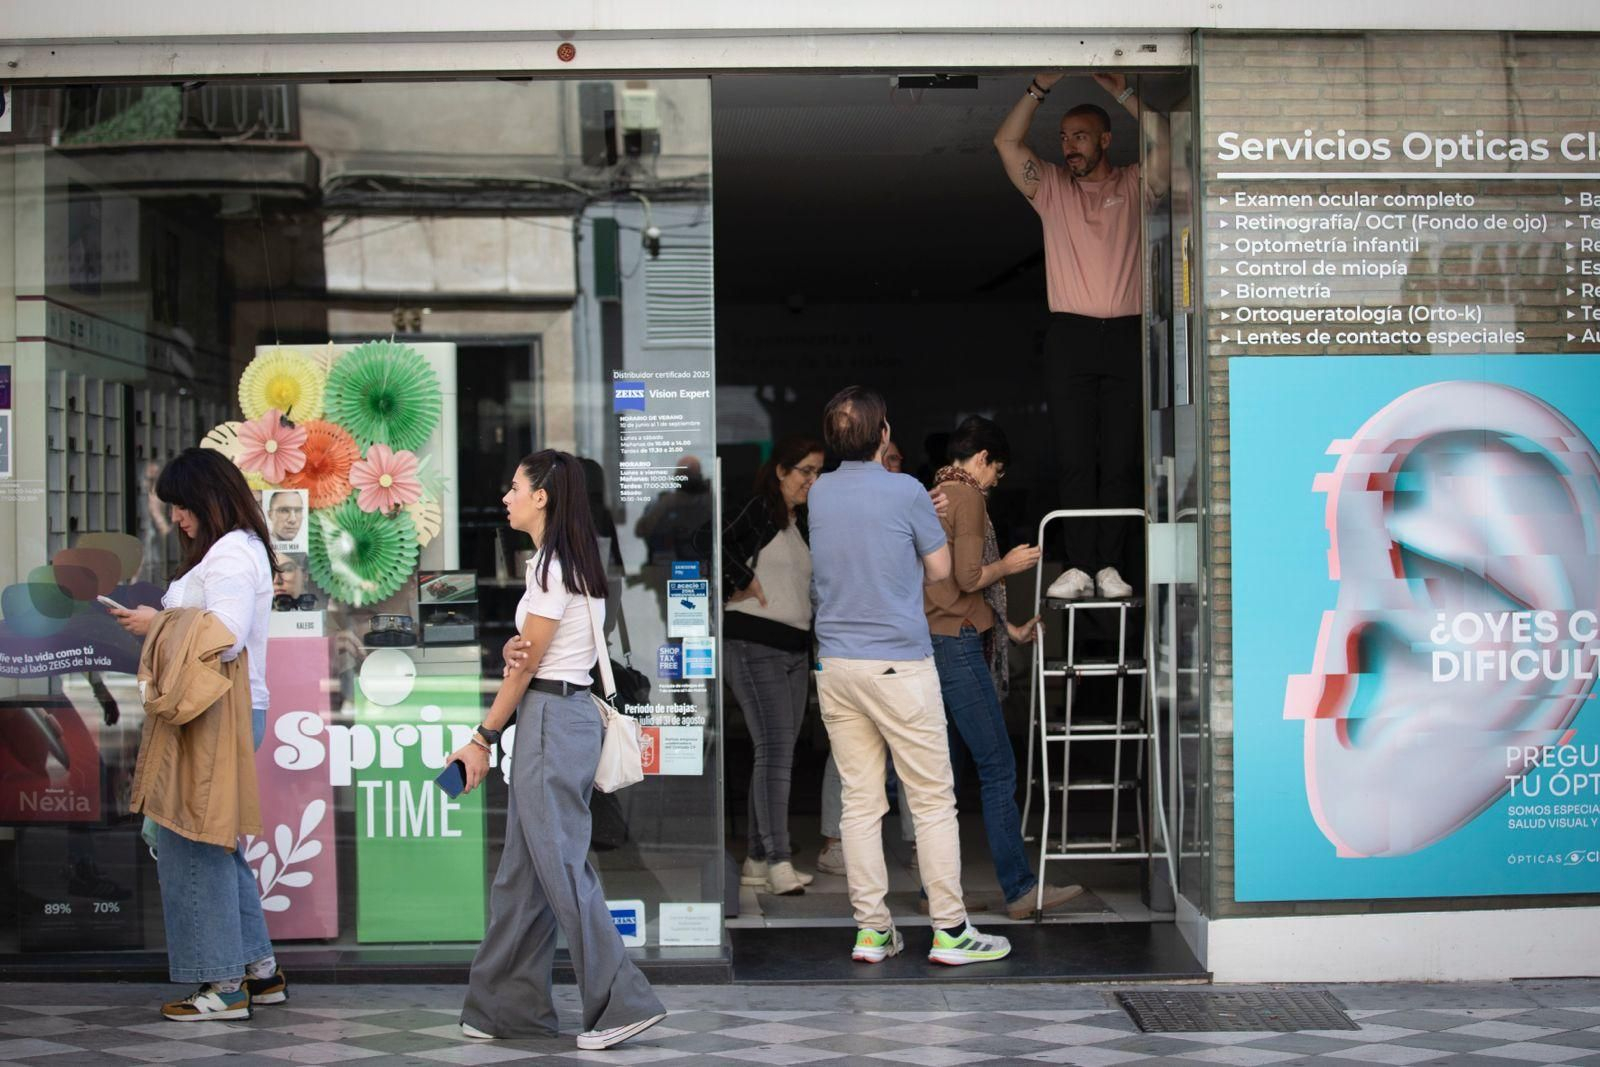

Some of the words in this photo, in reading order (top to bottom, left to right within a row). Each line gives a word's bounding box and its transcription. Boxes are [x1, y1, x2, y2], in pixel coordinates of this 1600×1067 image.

[1217, 129, 1392, 162] Servicios
[1402, 130, 1549, 167] Opticas
[1560, 131, 1600, 162] Cl
[1235, 192, 1313, 208] Examen
[1318, 191, 1378, 208] ocular
[1384, 192, 1475, 211] completo
[1235, 214, 1360, 233] Retinografía/
[1365, 215, 1407, 230] OCT
[1411, 214, 1478, 232] (Fondo
[1483, 214, 1508, 230] de
[1512, 214, 1547, 232] ojo)
[1235, 237, 1348, 257] Optometría
[1353, 237, 1420, 253] infantil
[1236, 260, 1306, 276] Control
[1312, 260, 1337, 276] de
[1342, 260, 1408, 280] miopía
[1236, 283, 1331, 299] Biometría
[1236, 305, 1403, 325] Ortoqueratología
[1408, 305, 1482, 325] (Orto-k)
[1237, 329, 1301, 345] Lentes
[1305, 329, 1331, 345] de
[1335, 330, 1422, 346] contacto
[1426, 329, 1525, 348] especiales
[613, 371, 653, 379] Distribuidor
[654, 371, 691, 379] certificado
[692, 370, 710, 378] 2025
[615, 389, 645, 399] ZEISS
[649, 389, 677, 399] Vision
[680, 389, 710, 400] Expert
[1430, 610, 1559, 646] ¿OYES
[12, 655, 23, 664] ve
[24, 653, 34, 663] la
[34, 652, 54, 663] vida
[55, 648, 82, 659] como
[83, 645, 94, 655] tú
[659, 647, 680, 655] SHOP
[659, 654, 675, 662] TAX
[20, 664, 28, 674] al
[29, 662, 48, 673] lado
[49, 659, 71, 671] ZEISS
[72, 657, 83, 667] de
[84, 656, 92, 666] la
[93, 656, 112, 666] vida
[624, 703, 654, 714] Periodo
[655, 703, 665, 714] de
[666, 702, 697, 715] rebajas:
[681, 715, 705, 727] agosto
[1506, 744, 1599, 768] PREGU
[1504, 774, 1541, 797] TU
[1549, 767, 1600, 797] ÓPT
[19, 790, 91, 812] Nexia
[357, 780, 462, 838] TIME
[1508, 805, 1551, 816] SOMOS
[1553, 804, 1600, 815] ESPECIA
[1508, 818, 1546, 829] SALUD
[1548, 817, 1589, 828] VISUAL
[1590, 817, 1599, 827] Y
[1507, 852, 1562, 865] ÓPTICAS
[44, 903, 72, 914] 89%
[93, 902, 120, 913] 70%
